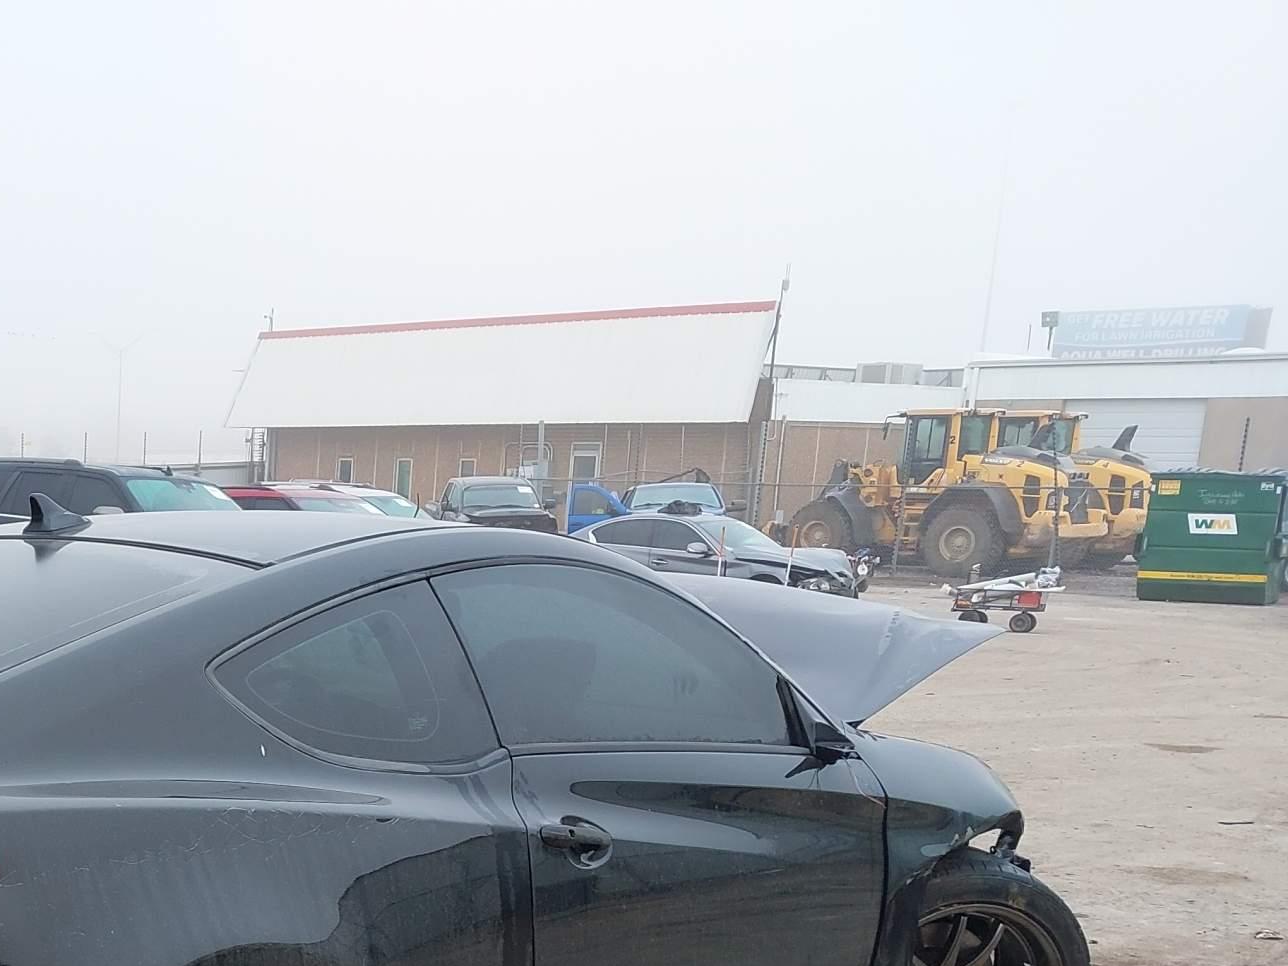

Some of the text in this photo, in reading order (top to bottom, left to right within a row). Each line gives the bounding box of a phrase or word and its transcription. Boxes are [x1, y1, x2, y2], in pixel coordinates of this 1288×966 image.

[1092, 312, 1144, 328] FREE
[1152, 309, 1230, 326] WATER
[1075, 333, 1099, 342] FOR
[1141, 328, 1216, 340] IRRIGATION
[1194, 519, 1232, 529] WM
